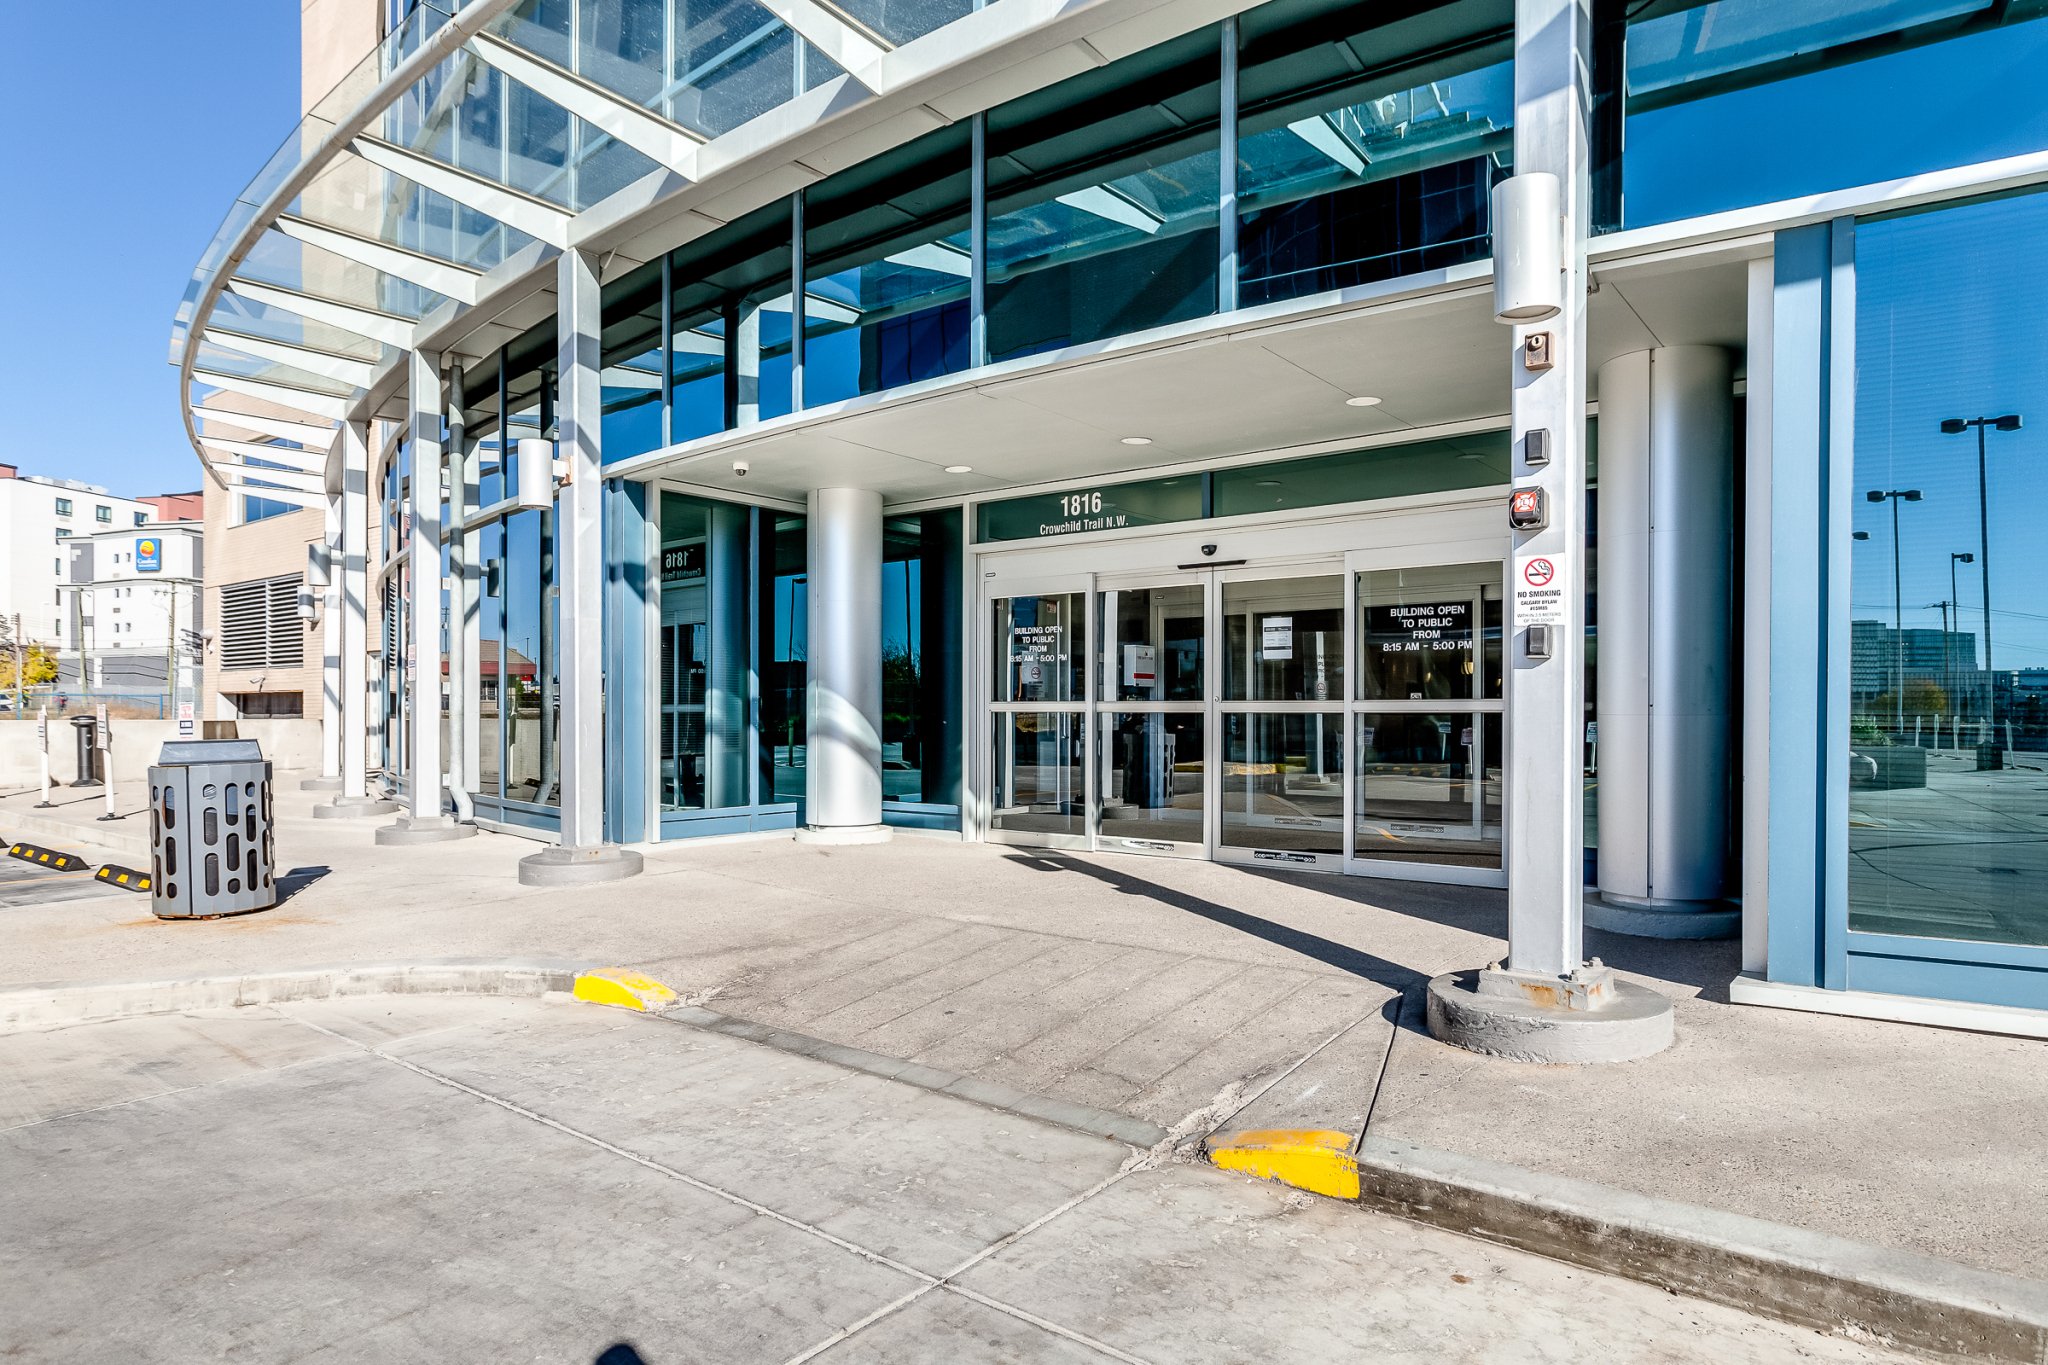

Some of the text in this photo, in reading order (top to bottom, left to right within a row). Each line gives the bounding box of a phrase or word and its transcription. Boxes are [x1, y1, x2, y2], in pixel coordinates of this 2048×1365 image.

[1060, 491, 1102, 517] 1816
[1040, 514, 1129, 535] Crowchild Trail N.W.
[1529, 589, 1561, 598] SMOKING
[1390, 605, 1465, 617] BUILDING OPEN
[1401, 617, 1453, 628] TO PUBLIC
[1014, 625, 1063, 635] BUILDING OPEN
[1412, 629, 1441, 640] FROM
[1022, 635, 1055, 644] TO PUBLIC
[1029, 645, 1047, 653] FROM
[1382, 642, 1402, 652] 8:15
[1404, 642, 1420, 651] AM
[1432, 641, 1455, 650] 5:00
[1457, 640, 1472, 649] PM
[1023, 654, 1034, 662] AM
[1040, 654, 1055, 662] 5:00
[1057, 653, 1068, 661] PM
